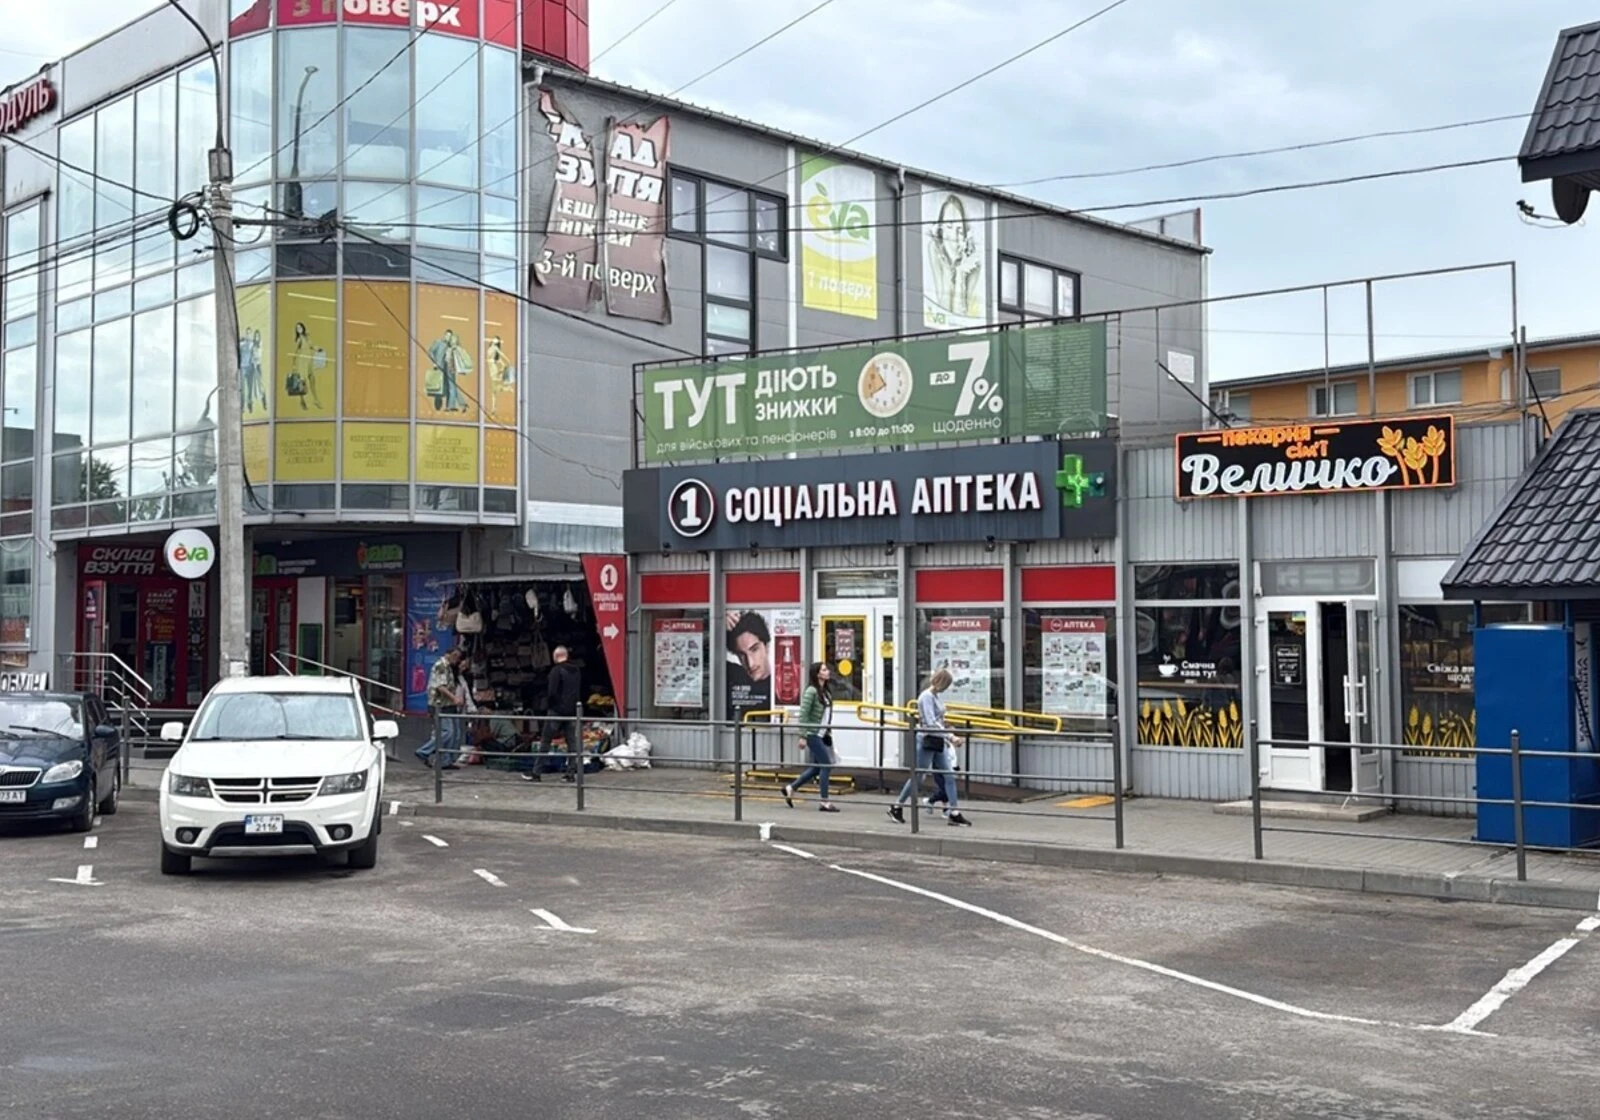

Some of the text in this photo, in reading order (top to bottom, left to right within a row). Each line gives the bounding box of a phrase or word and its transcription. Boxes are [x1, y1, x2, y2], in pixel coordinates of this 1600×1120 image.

[654, 373, 746, 430] ТУТ
[755, 365, 837, 399] ДІЮТЬ
[856, 427, 876, 437] 8:00
[891, 423, 915, 434] 11:00
[933, 416, 1002, 434] щоденно
[656, 442, 677, 455] для
[762, 429, 837, 446] пенсіонерів
[1181, 452, 1398, 496] Величко
[679, 472, 1042, 527] 1 СОЦІАЛЬНА АПТЕКА
[92, 547, 156, 561] СКЛАД
[84, 560, 155, 575] ВЗУТТЯ
[605, 568, 613, 586] 1
[951, 620, 981, 628] АПТЕКА
[1063, 621, 1096, 629] АПТЕКА
[1181, 660, 1215, 669] Смачна
[1203, 670, 1217, 679] тут
